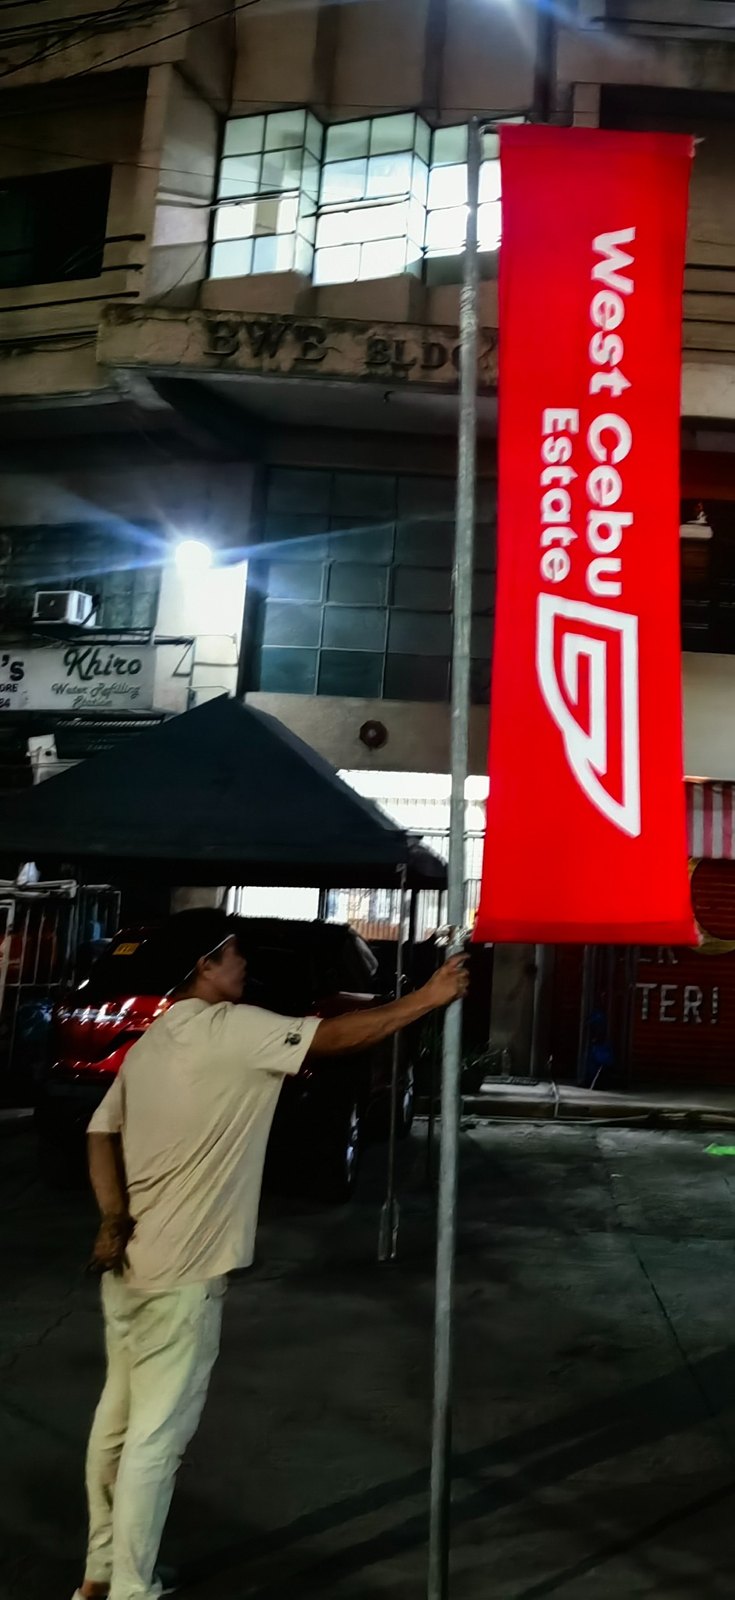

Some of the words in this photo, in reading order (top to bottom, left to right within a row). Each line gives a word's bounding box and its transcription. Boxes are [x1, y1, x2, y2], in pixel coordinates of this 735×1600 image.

[589, 226, 637, 398] West
[540, 407, 580, 584] Estate
[586, 412, 634, 598] Cebu
[63, 646, 143, 681] Khiro
